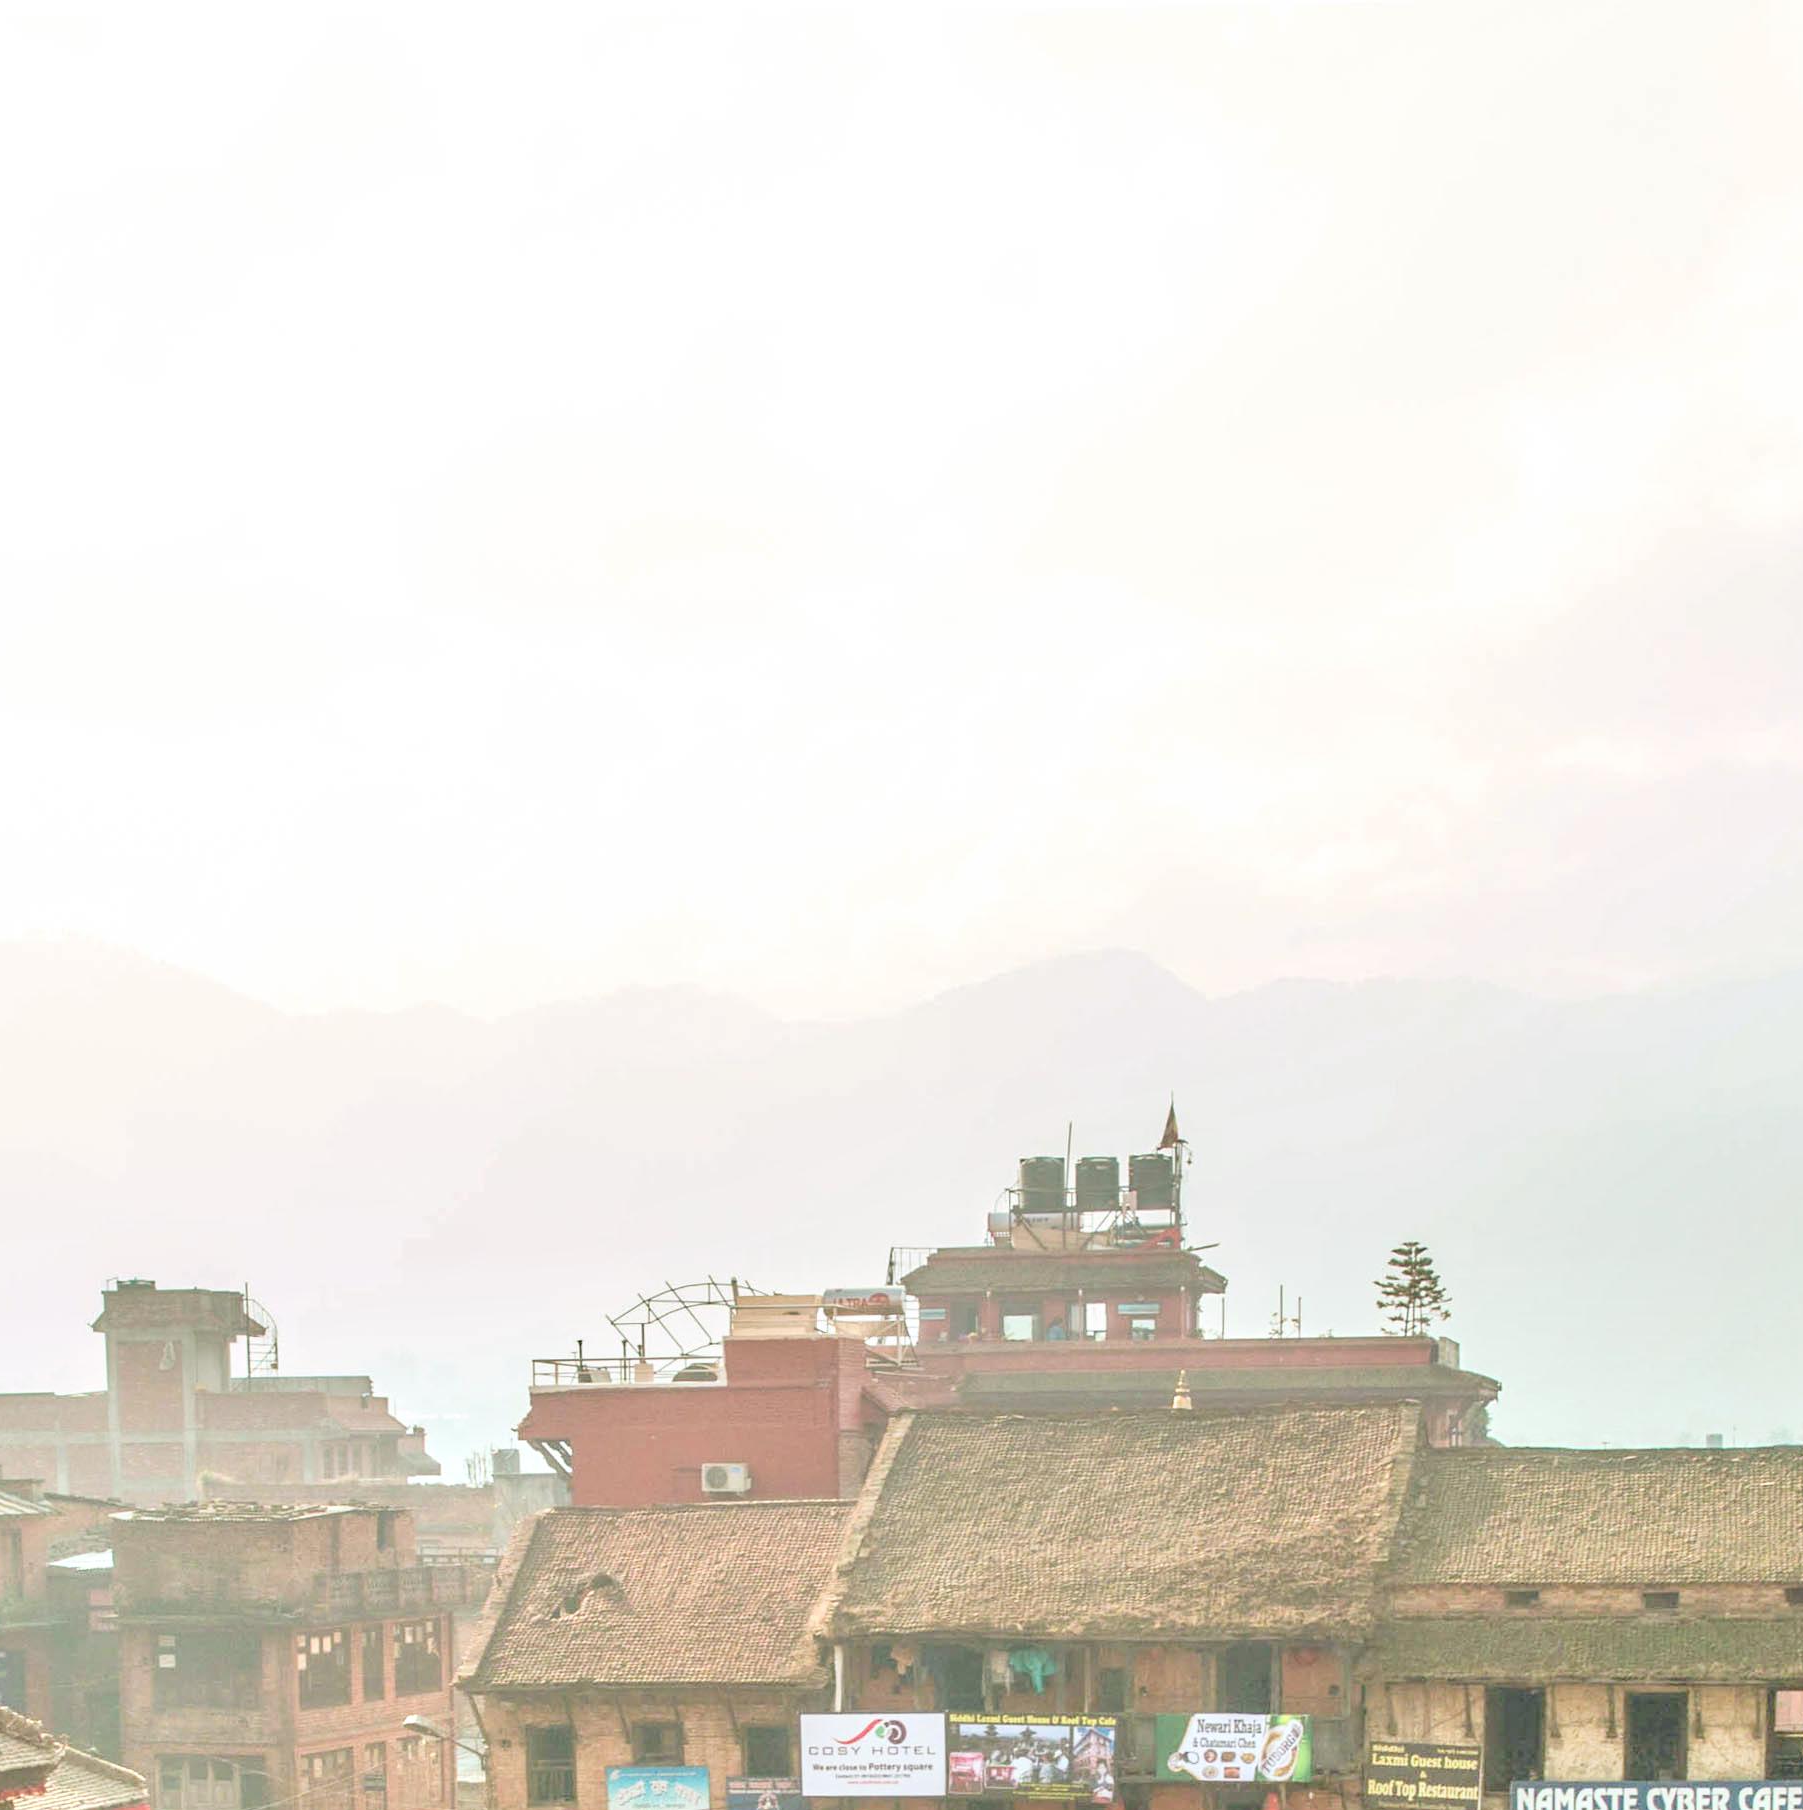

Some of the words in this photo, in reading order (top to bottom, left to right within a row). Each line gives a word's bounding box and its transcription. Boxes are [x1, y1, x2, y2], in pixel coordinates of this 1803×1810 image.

[1197, 1719, 1231, 1734] Newari
[1233, 1719, 1262, 1737] Khaja
[808, 1746, 861, 1756] COSY
[871, 1745, 936, 1756] HOTEL
[838, 1763, 858, 1771] close
[869, 1762, 901, 1774] Pottery
[903, 1763, 933, 1774] square
[1371, 1753, 1409, 1767] Laxmi
[1410, 1754, 1442, 1768] Guest
[1444, 1756, 1478, 1770] house
[1367, 1779, 1394, 1796] Roof
[1395, 1780, 1417, 1801] Top
[1417, 1781, 1479, 1800] Restaurant
